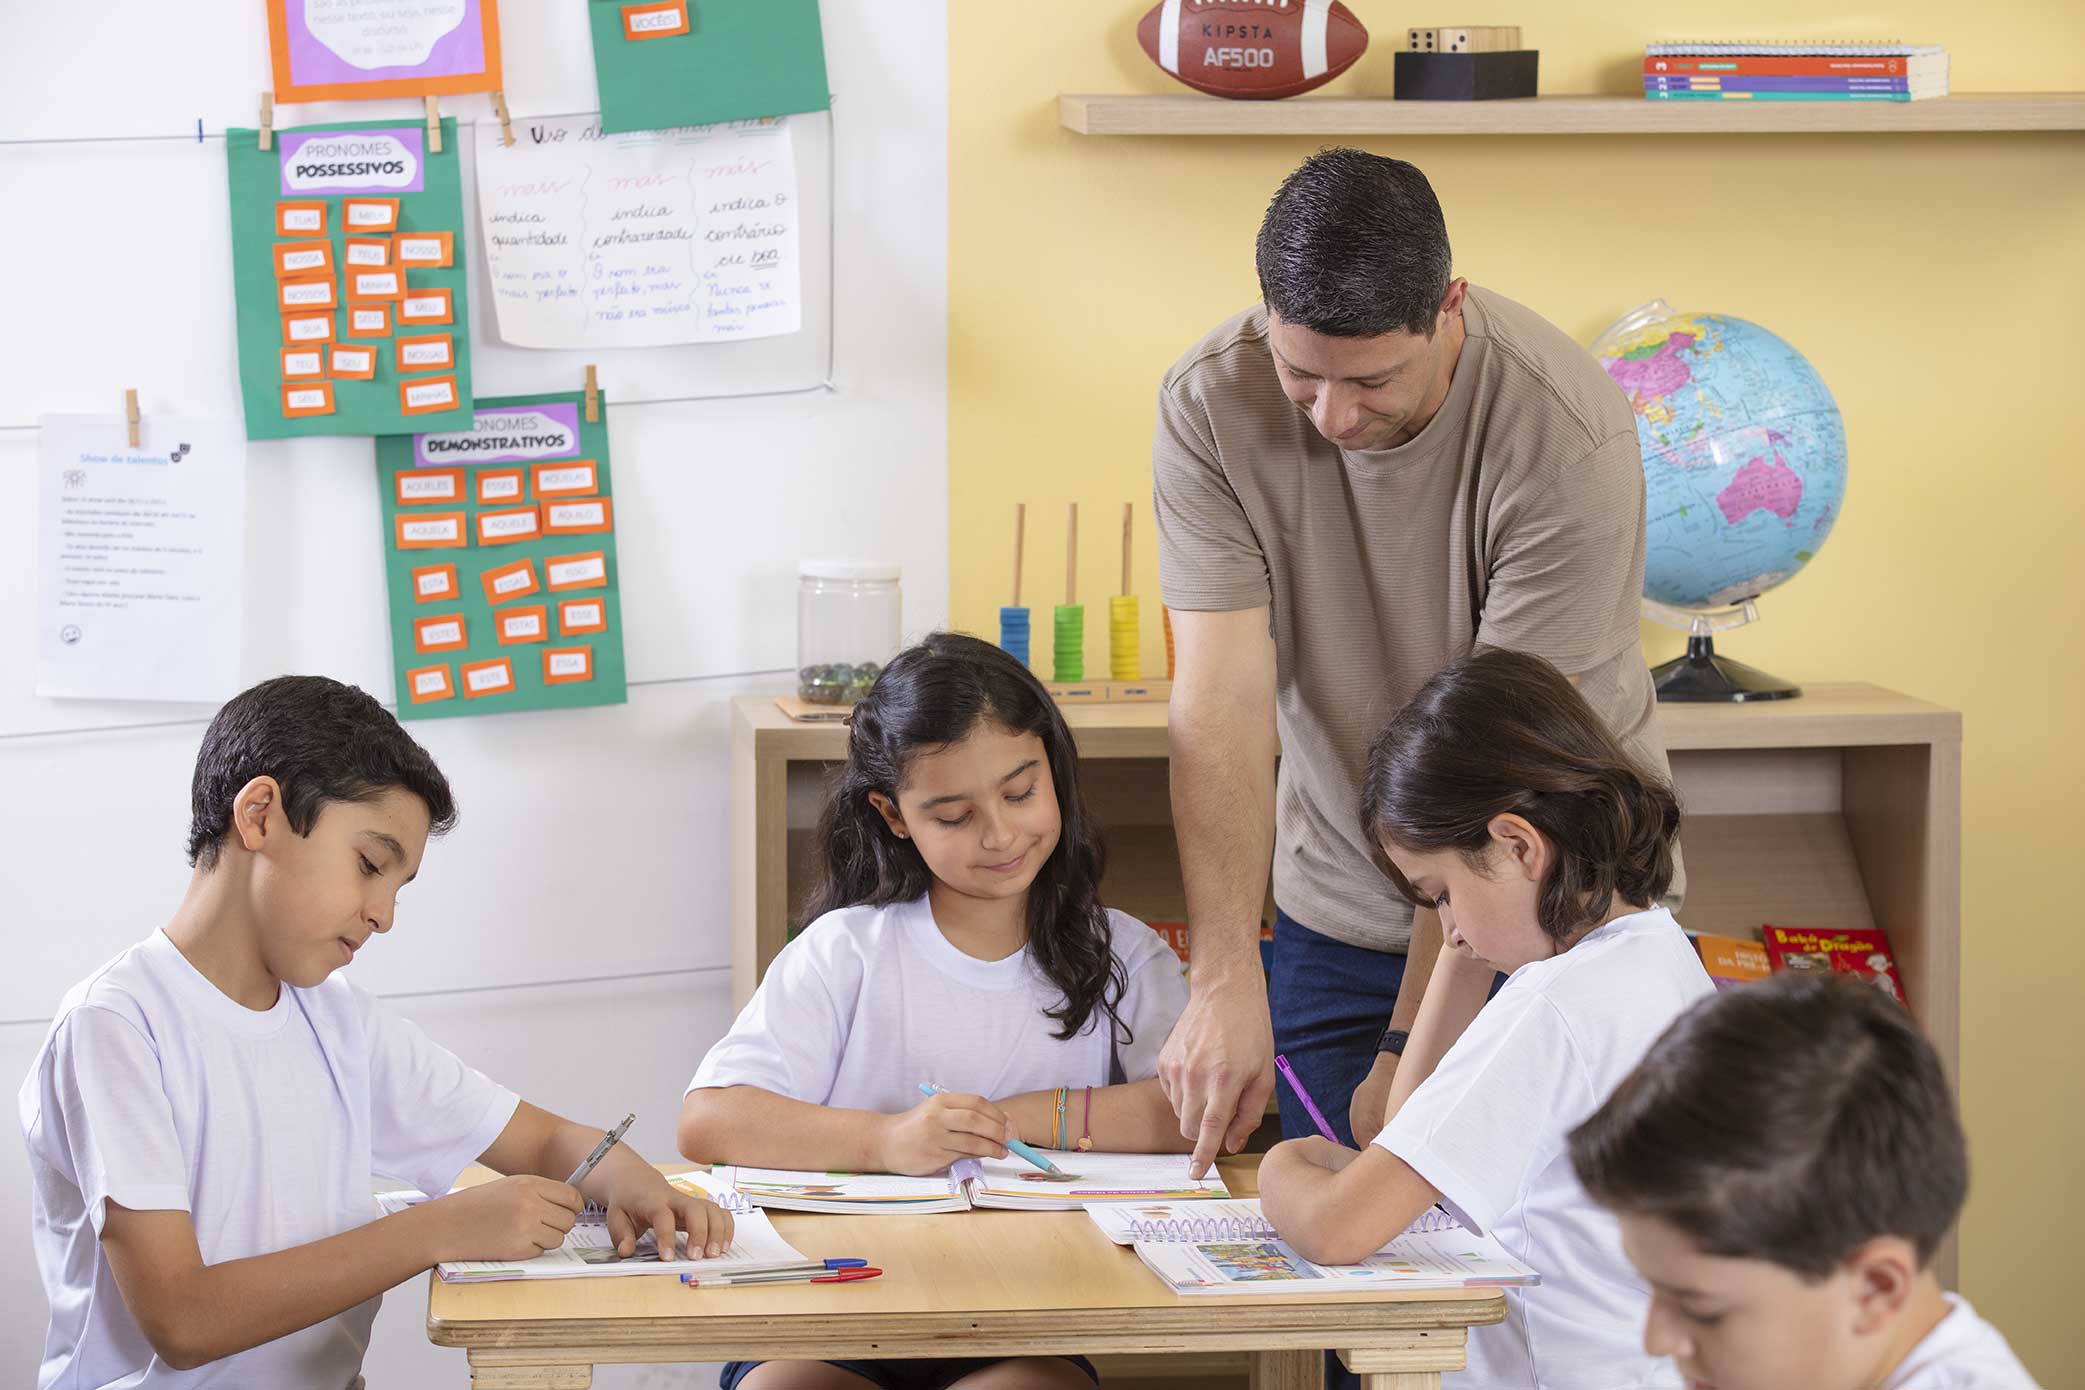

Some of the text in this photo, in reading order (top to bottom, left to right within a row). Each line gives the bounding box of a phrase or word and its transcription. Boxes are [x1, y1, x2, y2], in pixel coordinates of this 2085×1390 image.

[1202, 24, 1273, 39] KIPSTA
[1203, 47, 1275, 68] AF500
[306, 142, 392, 159] PRONOMES
[296, 161, 404, 178] POSSESSIVOS
[404, 245, 439, 257] NOSSO
[472, 415, 539, 434] ONOMES
[428, 434, 567, 454] DEMONSTRATIVOS
